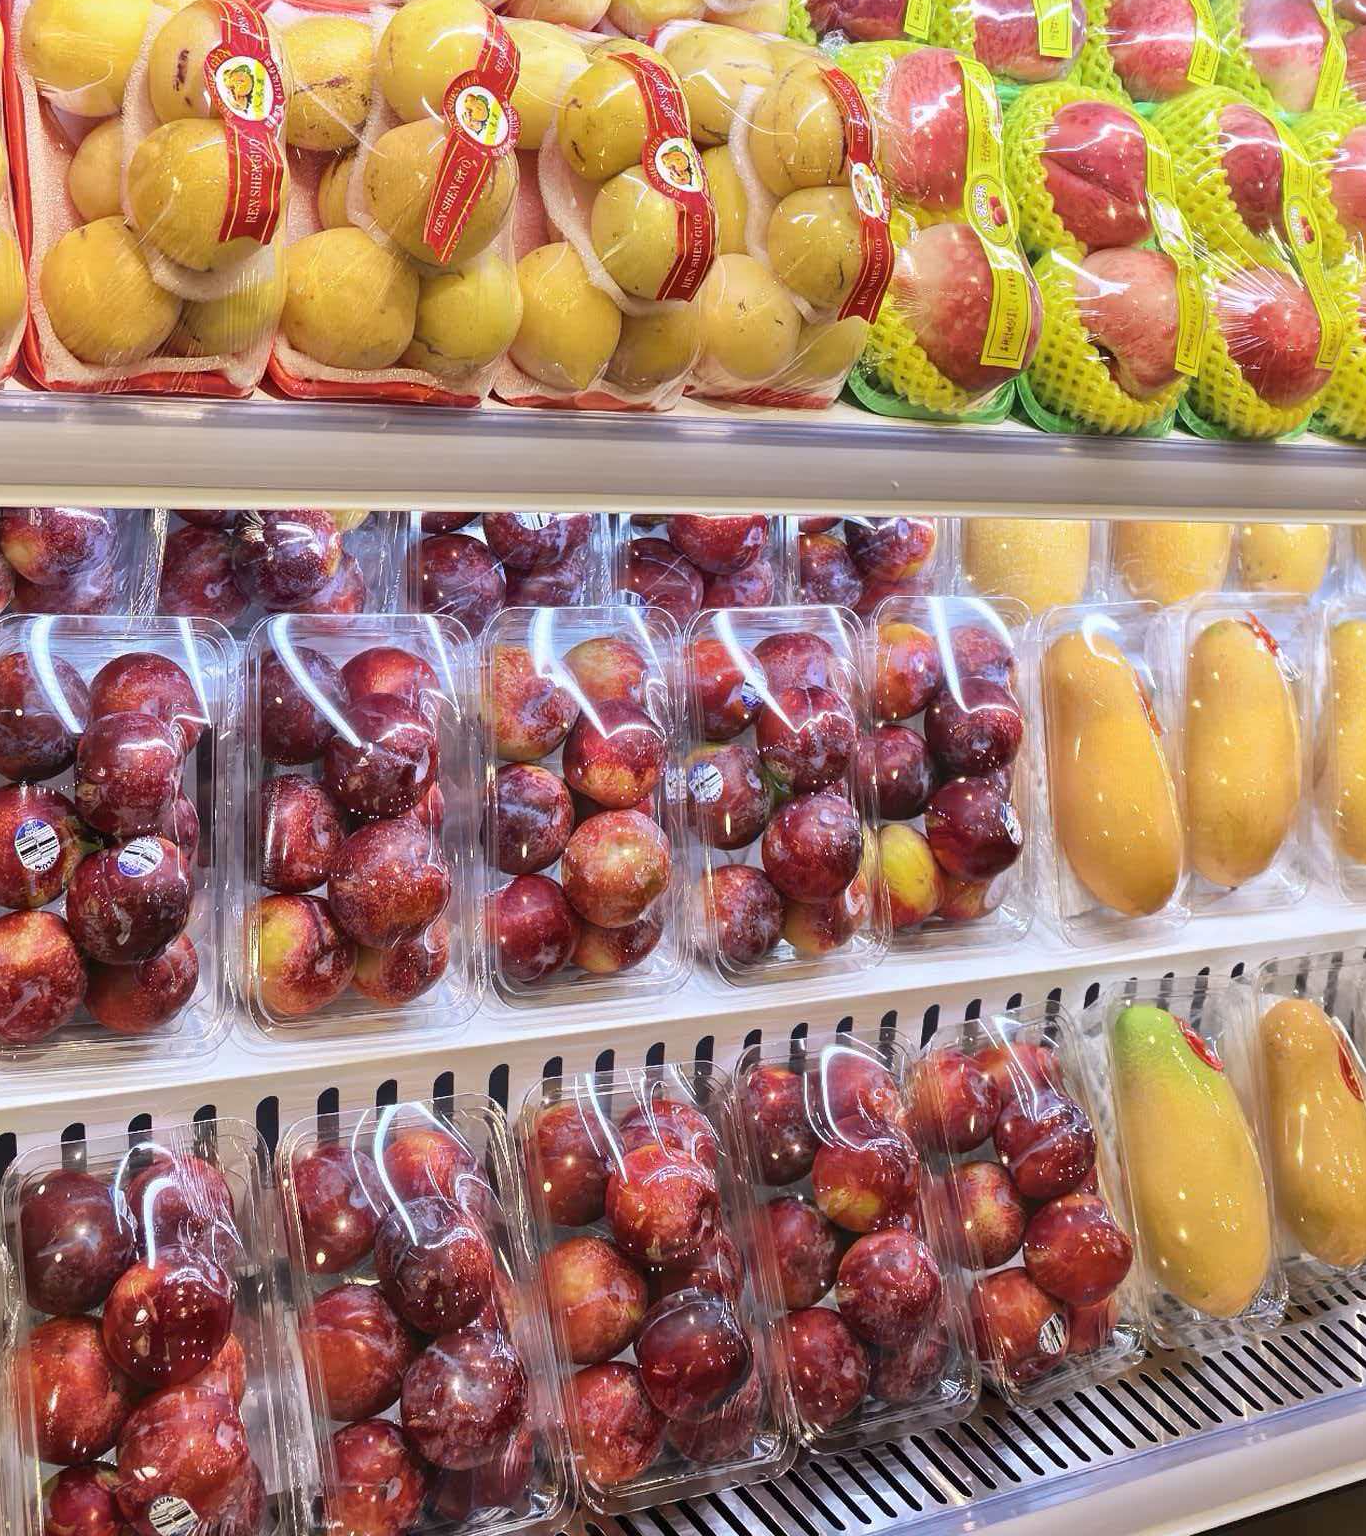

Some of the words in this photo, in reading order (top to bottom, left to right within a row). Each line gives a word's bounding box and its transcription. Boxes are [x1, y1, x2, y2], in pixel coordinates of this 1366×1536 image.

[251, 162, 262, 196] SHEN
[245, 199, 260, 223] REN
[434, 211, 447, 236] REN
[442, 182, 461, 213] SHEN
[693, 214, 702, 237] GUO
[691, 240, 702, 269] SHEN
[681, 269, 696, 288] REN
